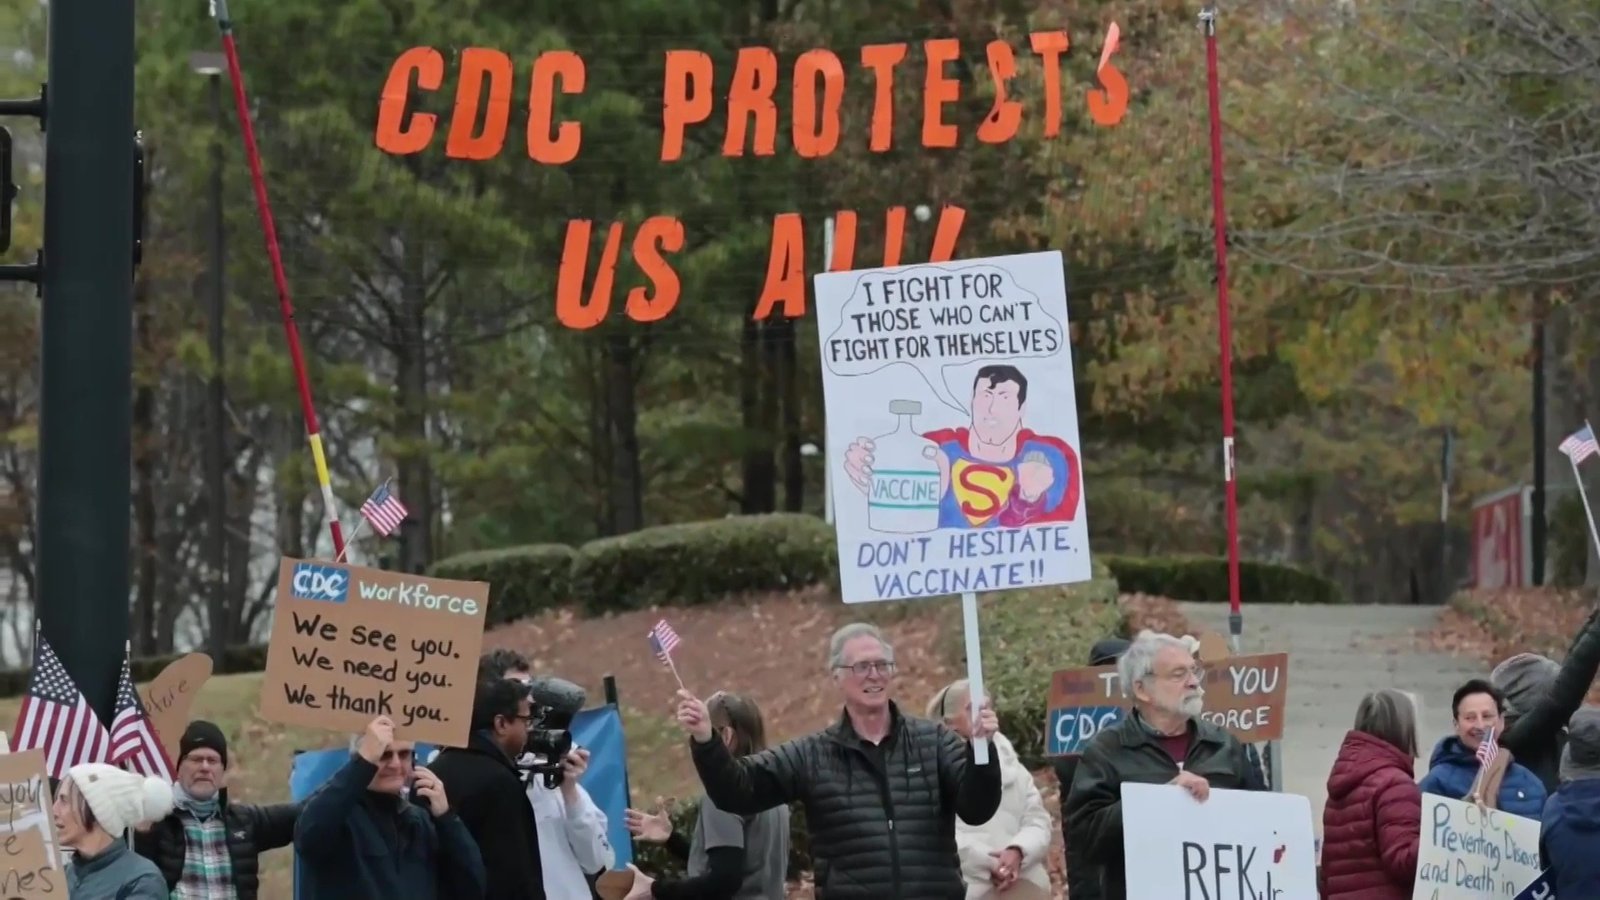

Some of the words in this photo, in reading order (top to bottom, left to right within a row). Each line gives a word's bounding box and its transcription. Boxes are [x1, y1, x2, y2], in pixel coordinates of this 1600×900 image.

[375, 46, 585, 164] CDC
[661, 22, 1128, 161] PROTESTS
[556, 216, 684, 328] US
[863, 282, 874, 306] I
[883, 275, 953, 304] FIGHT
[962, 274, 1003, 299] FOR
[851, 308, 921, 334] THOSE
[930, 305, 972, 326] WHO
[980, 302, 1032, 324] CAN'T
[830, 338, 889, 362] FIGHT
[895, 335, 930, 358] FOR
[934, 329, 1057, 356] THEMSELVES
[871, 480, 939, 502] VACCINE
[960, 465, 1008, 516] S
[857, 538, 932, 568] DON'T
[949, 526, 1078, 558] HESITATE,
[293, 570, 347, 597] CDC
[873, 559, 1044, 597] VACCINATE!!
[292, 611, 338, 641] We
[351, 625, 396, 651] see
[412, 639, 460, 664] you.
[292, 646, 334, 670] We
[344, 660, 397, 682] need
[406, 670, 452, 693] you.
[1229, 666, 1279, 695] YOU
[284, 683, 321, 708] We
[327, 685, 393, 715] thank
[403, 704, 449, 726] you.
[1433, 803, 1500, 871] Preventing
[1182, 841, 1257, 900] RFK
[1420, 859, 1449, 883] and
[1456, 858, 1494, 892] Death
[1502, 874, 1515, 896] in
